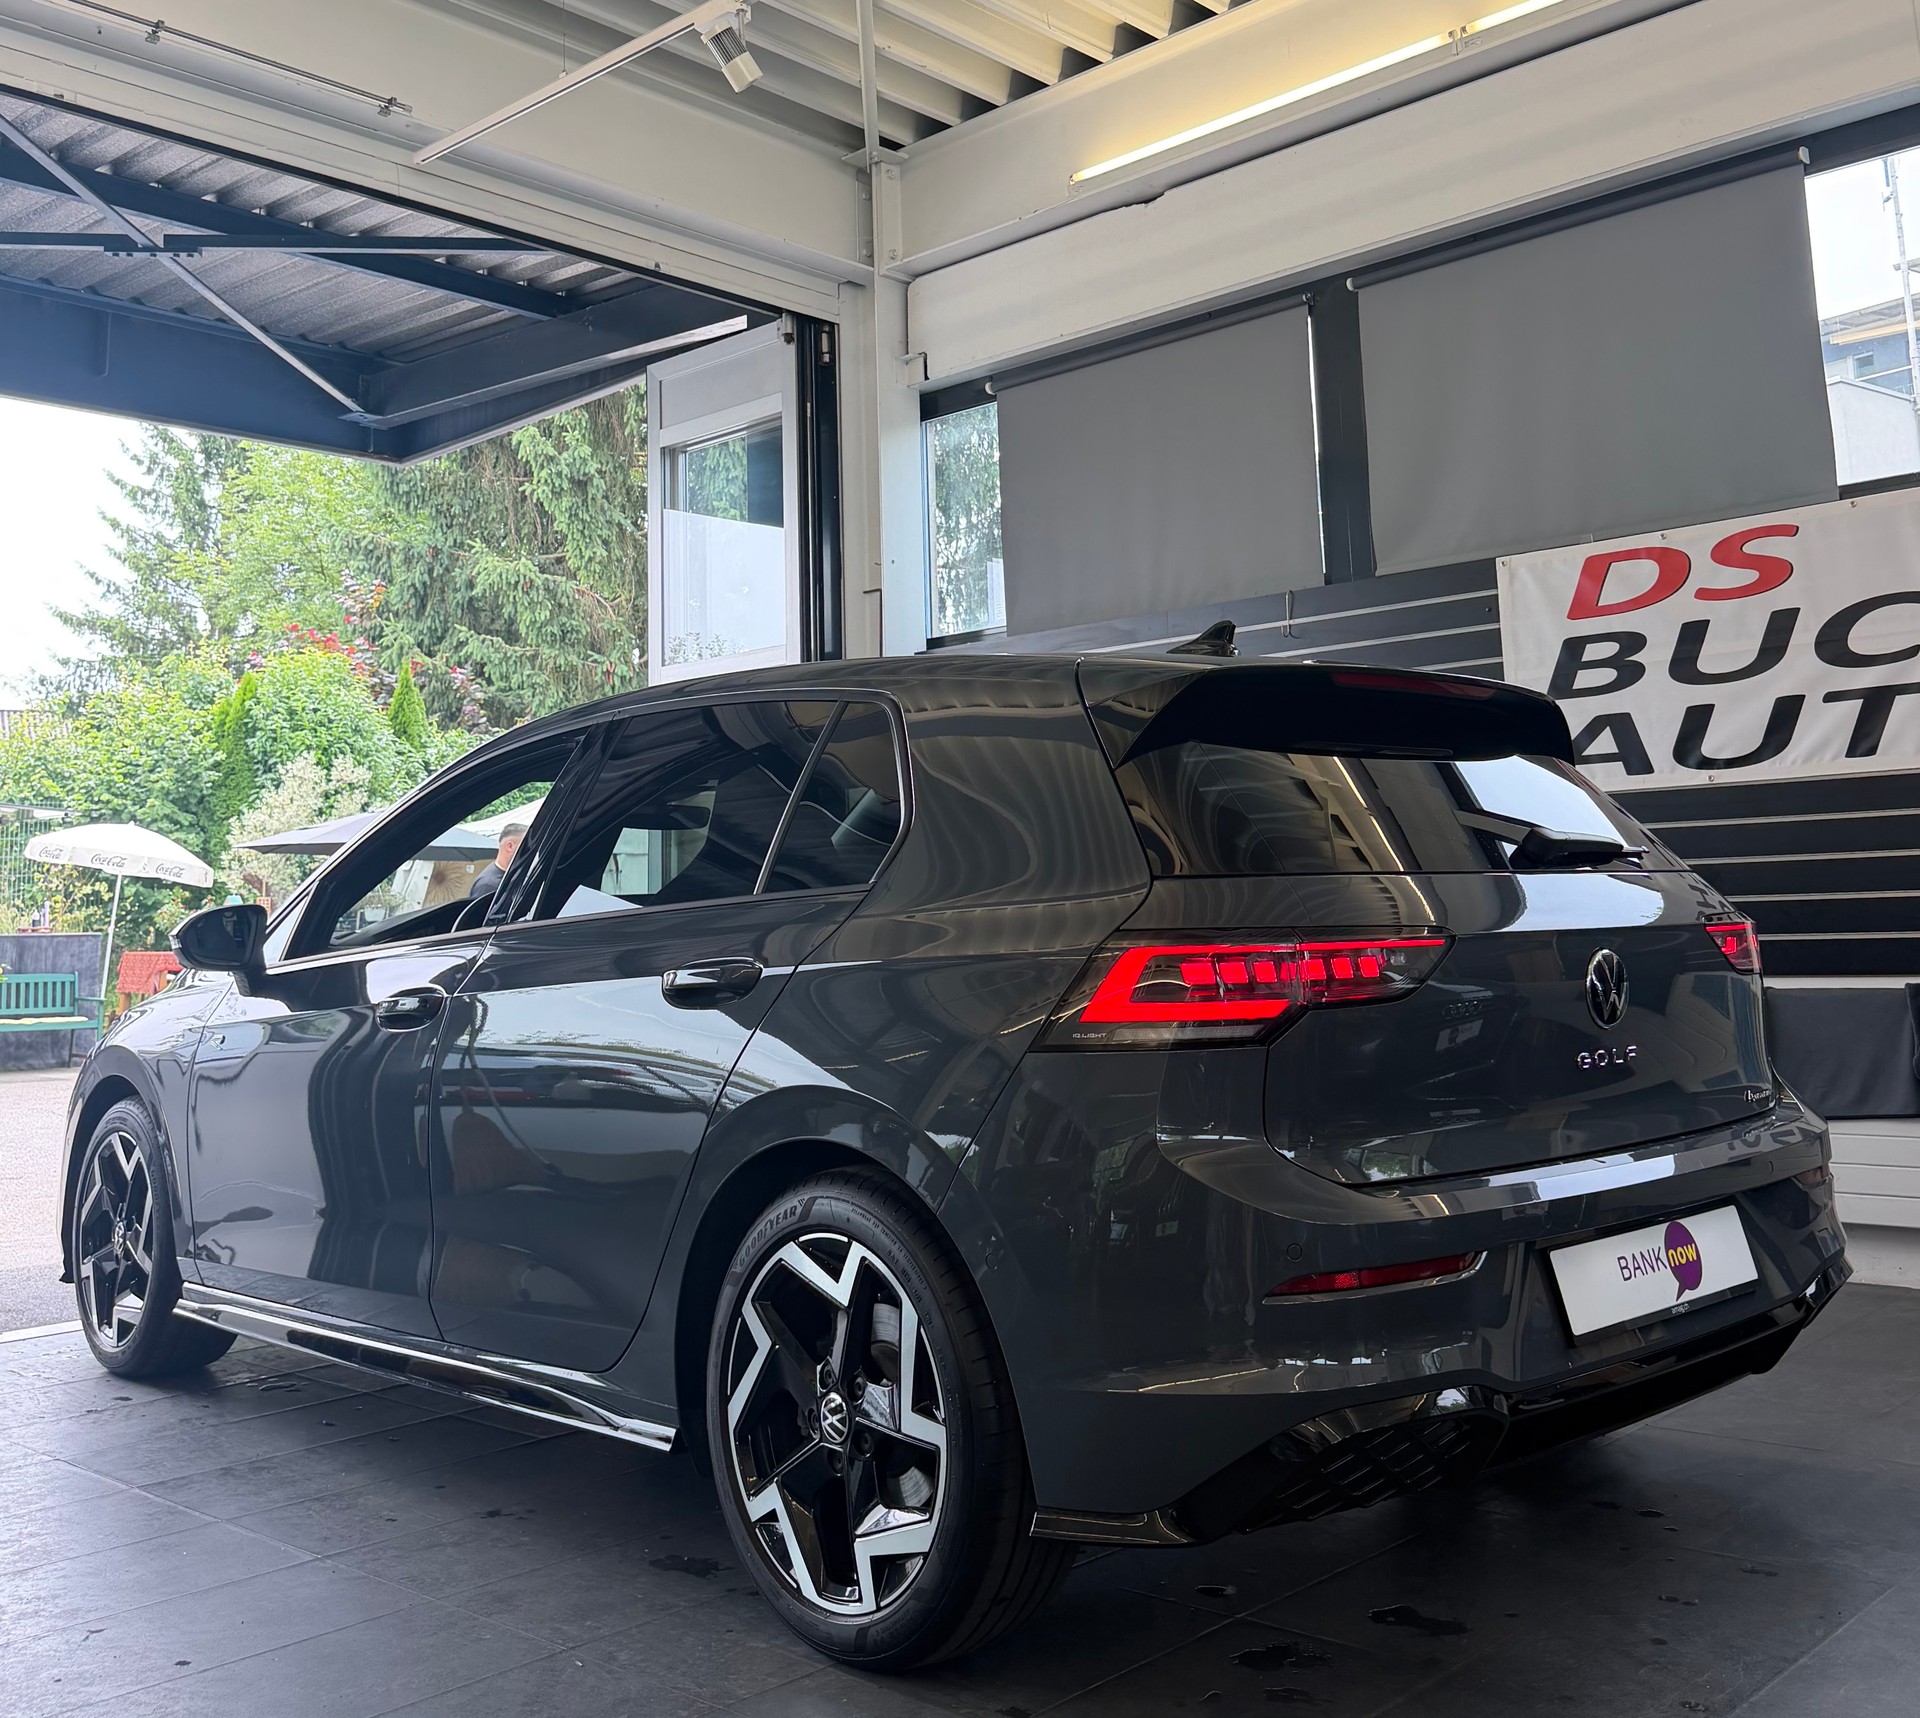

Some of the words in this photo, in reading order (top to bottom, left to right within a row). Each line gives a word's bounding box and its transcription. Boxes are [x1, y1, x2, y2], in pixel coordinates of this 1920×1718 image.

[1566, 524, 1799, 620] DS
[1546, 590, 1920, 700] BUC
[1573, 683, 1920, 776] AUT
[1576, 1046, 1637, 1070] GOLF
[739, 1205, 798, 1267] GOODYEAR
[1617, 1246, 1667, 1282] BANK
[1668, 1243, 1697, 1268] now
